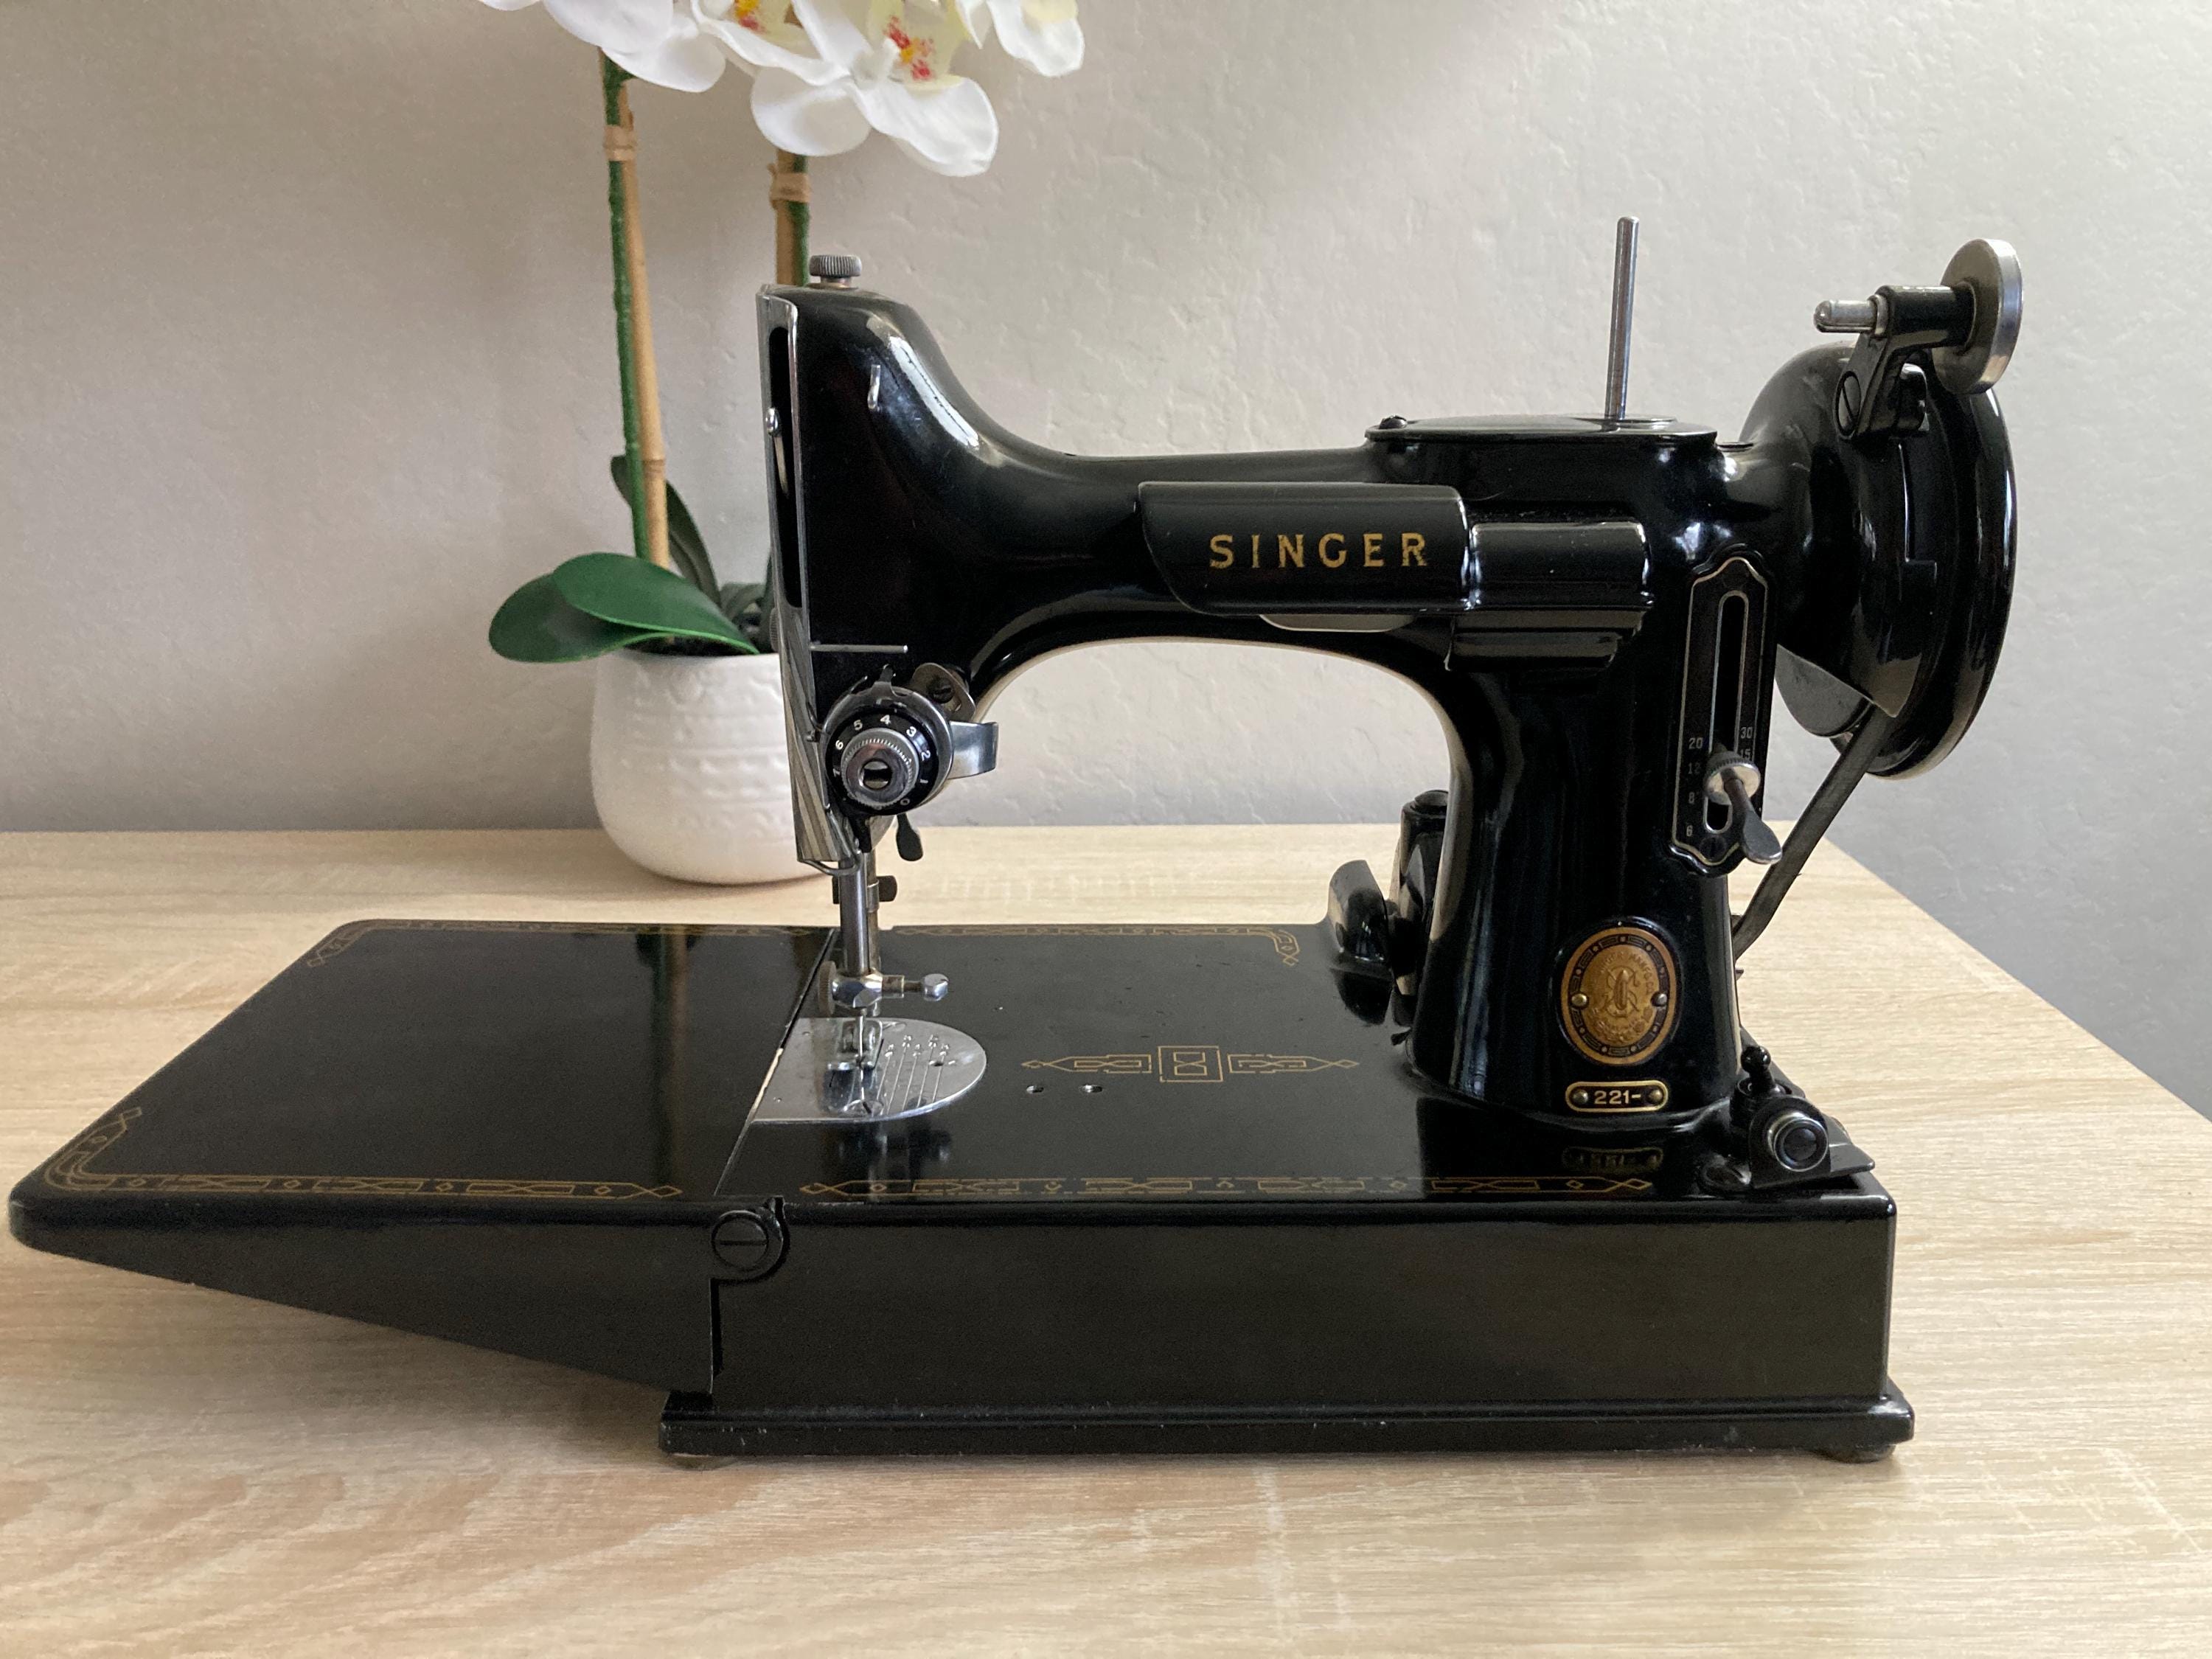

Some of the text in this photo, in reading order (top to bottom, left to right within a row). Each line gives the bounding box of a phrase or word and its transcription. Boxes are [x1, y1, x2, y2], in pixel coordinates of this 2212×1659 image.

[1209, 532, 1427, 568] SINGER
[835, 740, 844, 750] 6
[853, 719, 863, 731] 5
[880, 714, 891, 726] 4
[906, 726, 917, 737] 3
[921, 749, 931, 761] 2
[1740, 727, 1753, 739] 30
[1688, 737, 1703, 749] 20
[1740, 748, 1751, 759] 15
[1688, 762, 1701, 774] 12
[1686, 825, 1694, 837] 6
[1594, 1090, 1641, 1105] 221-
